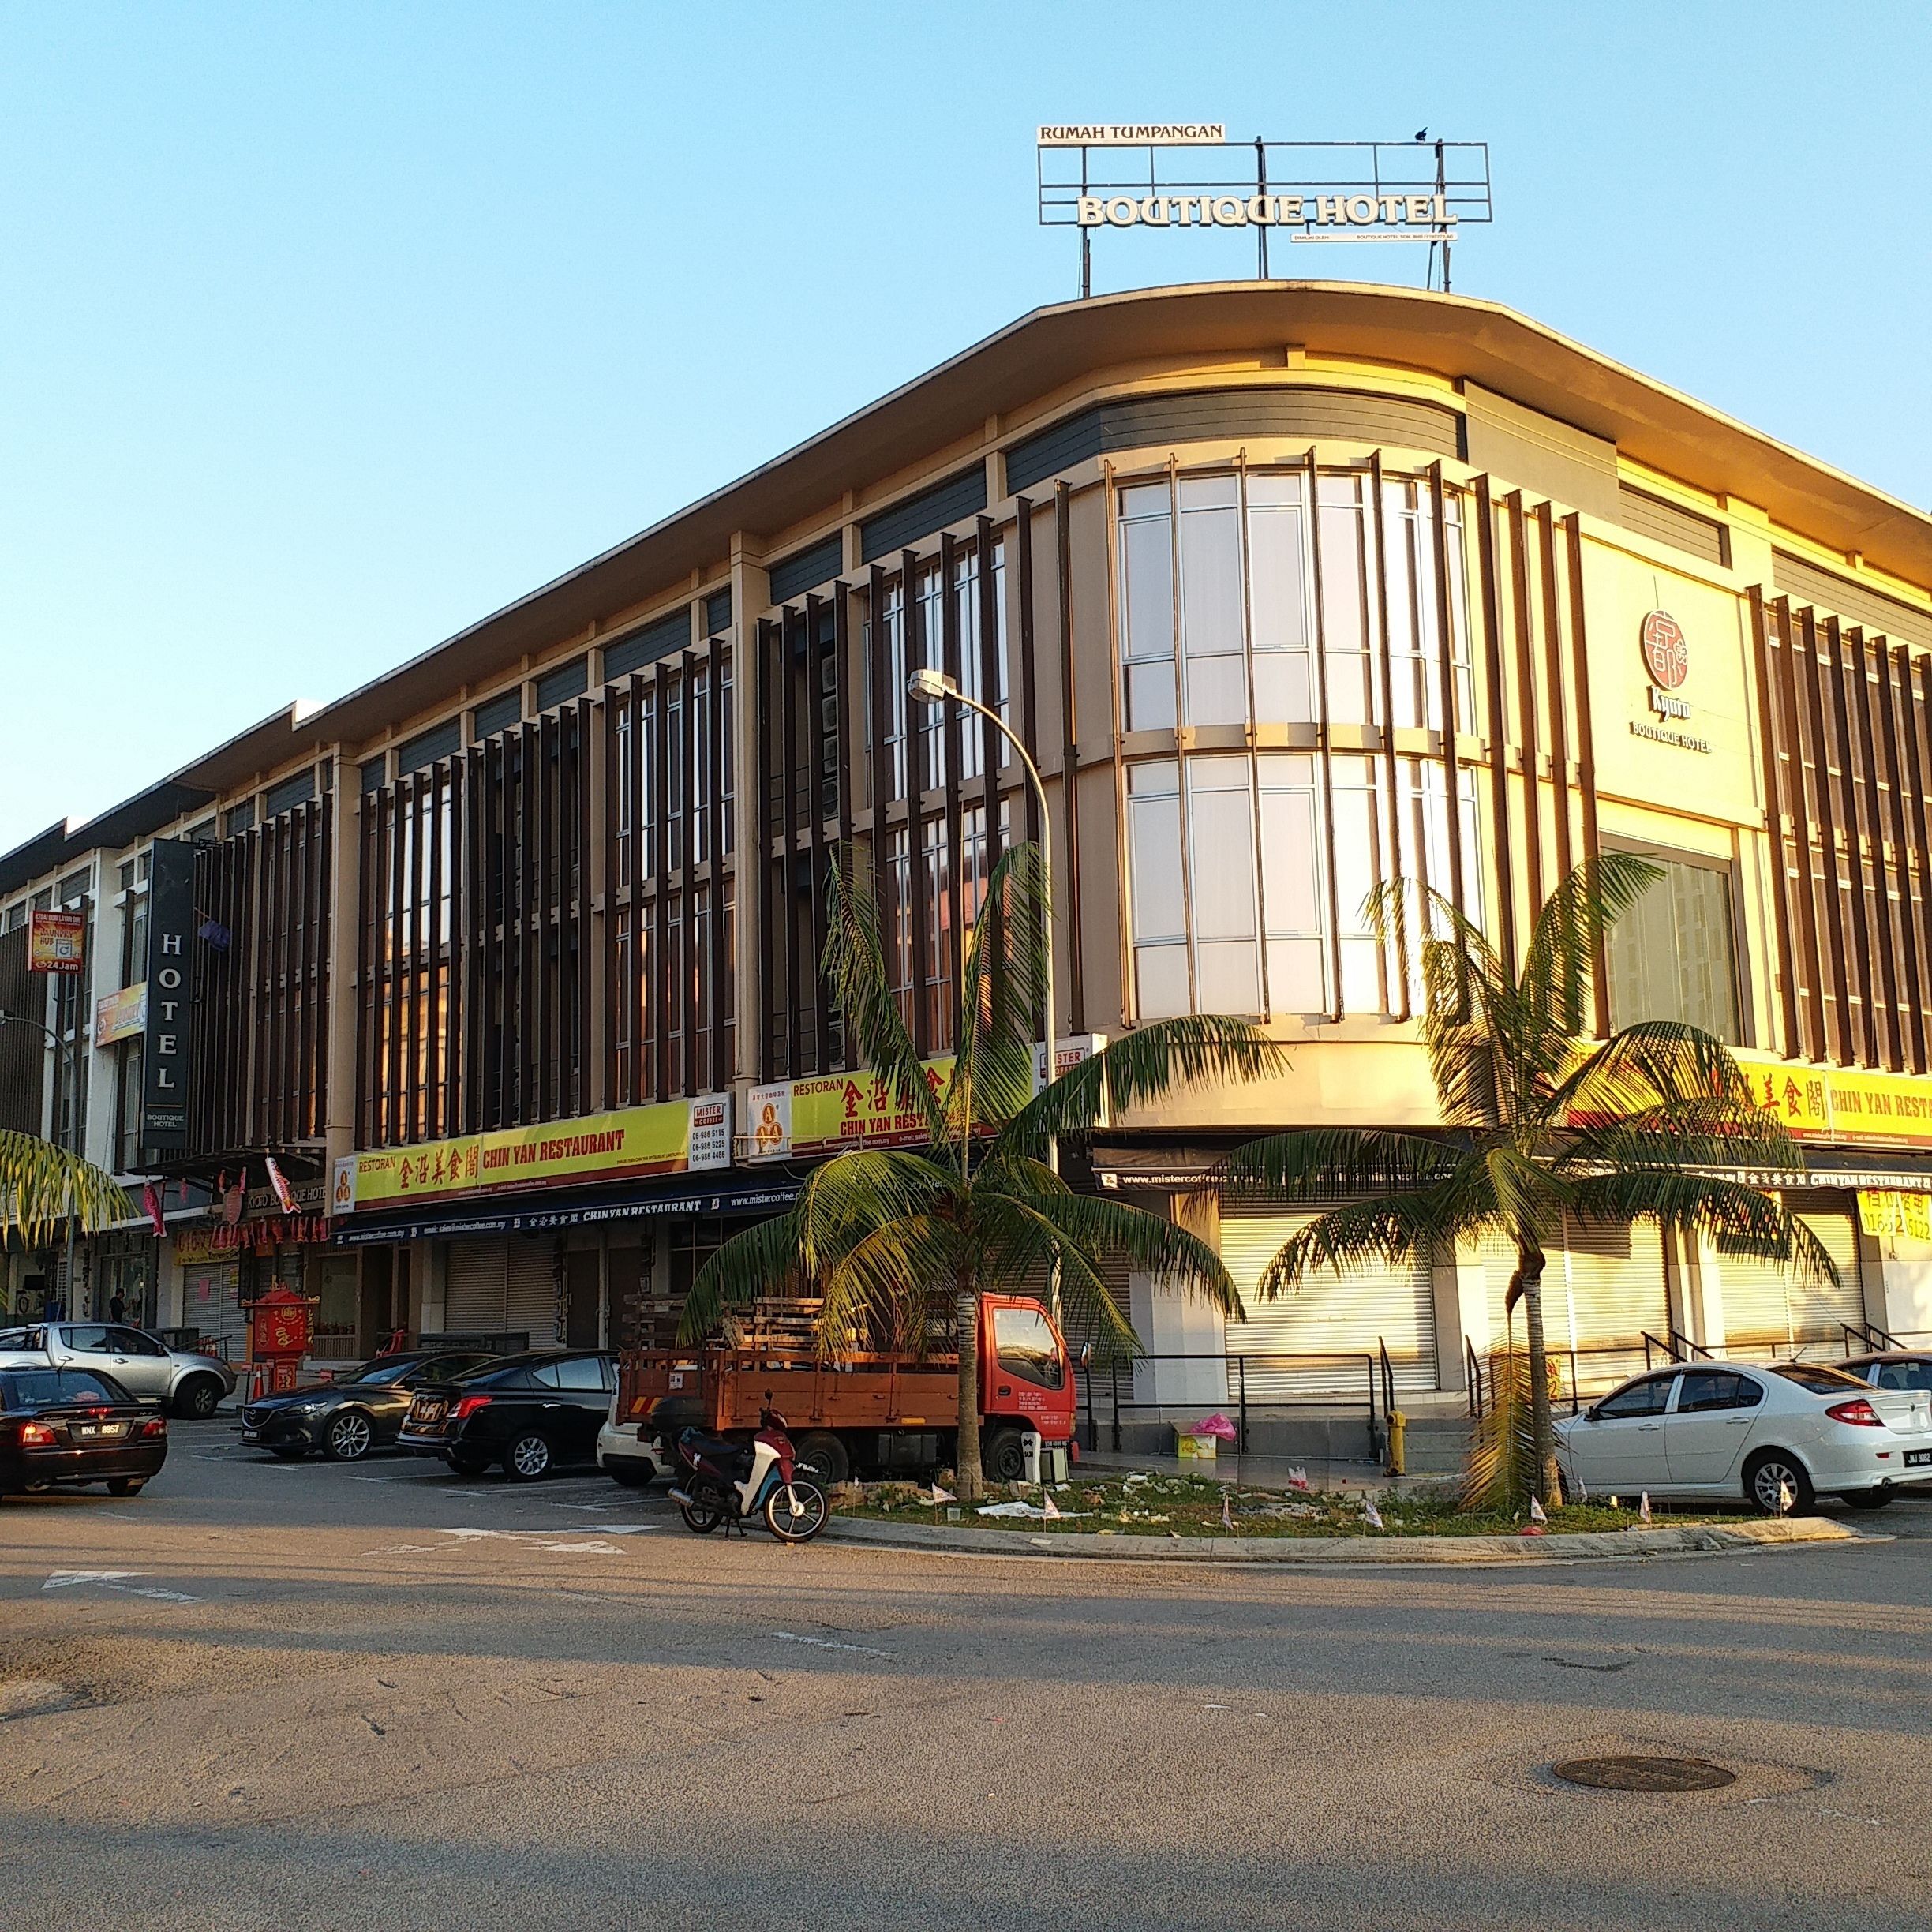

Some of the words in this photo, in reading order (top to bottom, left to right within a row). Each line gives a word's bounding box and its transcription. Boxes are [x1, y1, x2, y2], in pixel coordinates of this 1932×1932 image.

[1040, 126, 1105, 139] RUMAH
[1110, 125, 1222, 138] TUMPANGAN
[1077, 195, 1305, 227] BOUTIQUE
[1316, 194, 1458, 226] HOTEL
[1650, 685, 1691, 721] Kyoto
[1631, 721, 1680, 746] BOUTIQUE
[1681, 735, 1713, 753] HOTEL
[39, 937, 54, 945] HUB
[158, 934, 182, 1089] HOTEL
[793, 1078, 844, 1097] RESTORAN
[1830, 1089, 1863, 1114] CHIN
[1865, 1092, 1893, 1115] YAN
[147, 1114, 184, 1122] BOUTIQUE
[696, 1105, 721, 1118] MISTER
[698, 1116, 718, 1125] COFFEE
[840, 1119, 866, 1136] CHIN
[869, 1116, 891, 1133] YAN
[711, 1129, 724, 1138] 5115
[483, 1147, 510, 1169] CHIN
[513, 1143, 537, 1165] YAN
[539, 1129, 625, 1162] RESTAURANT
[712, 1140, 725, 1149] 5225
[358, 1156, 396, 1173] RESTORAN
[1859, 1174, 1922, 1189] RESTAURANT
[247, 1194, 268, 1209] KYOTO
[631, 1200, 702, 1215] RESTAURANT
[102, 1425, 118, 1434] 8957
